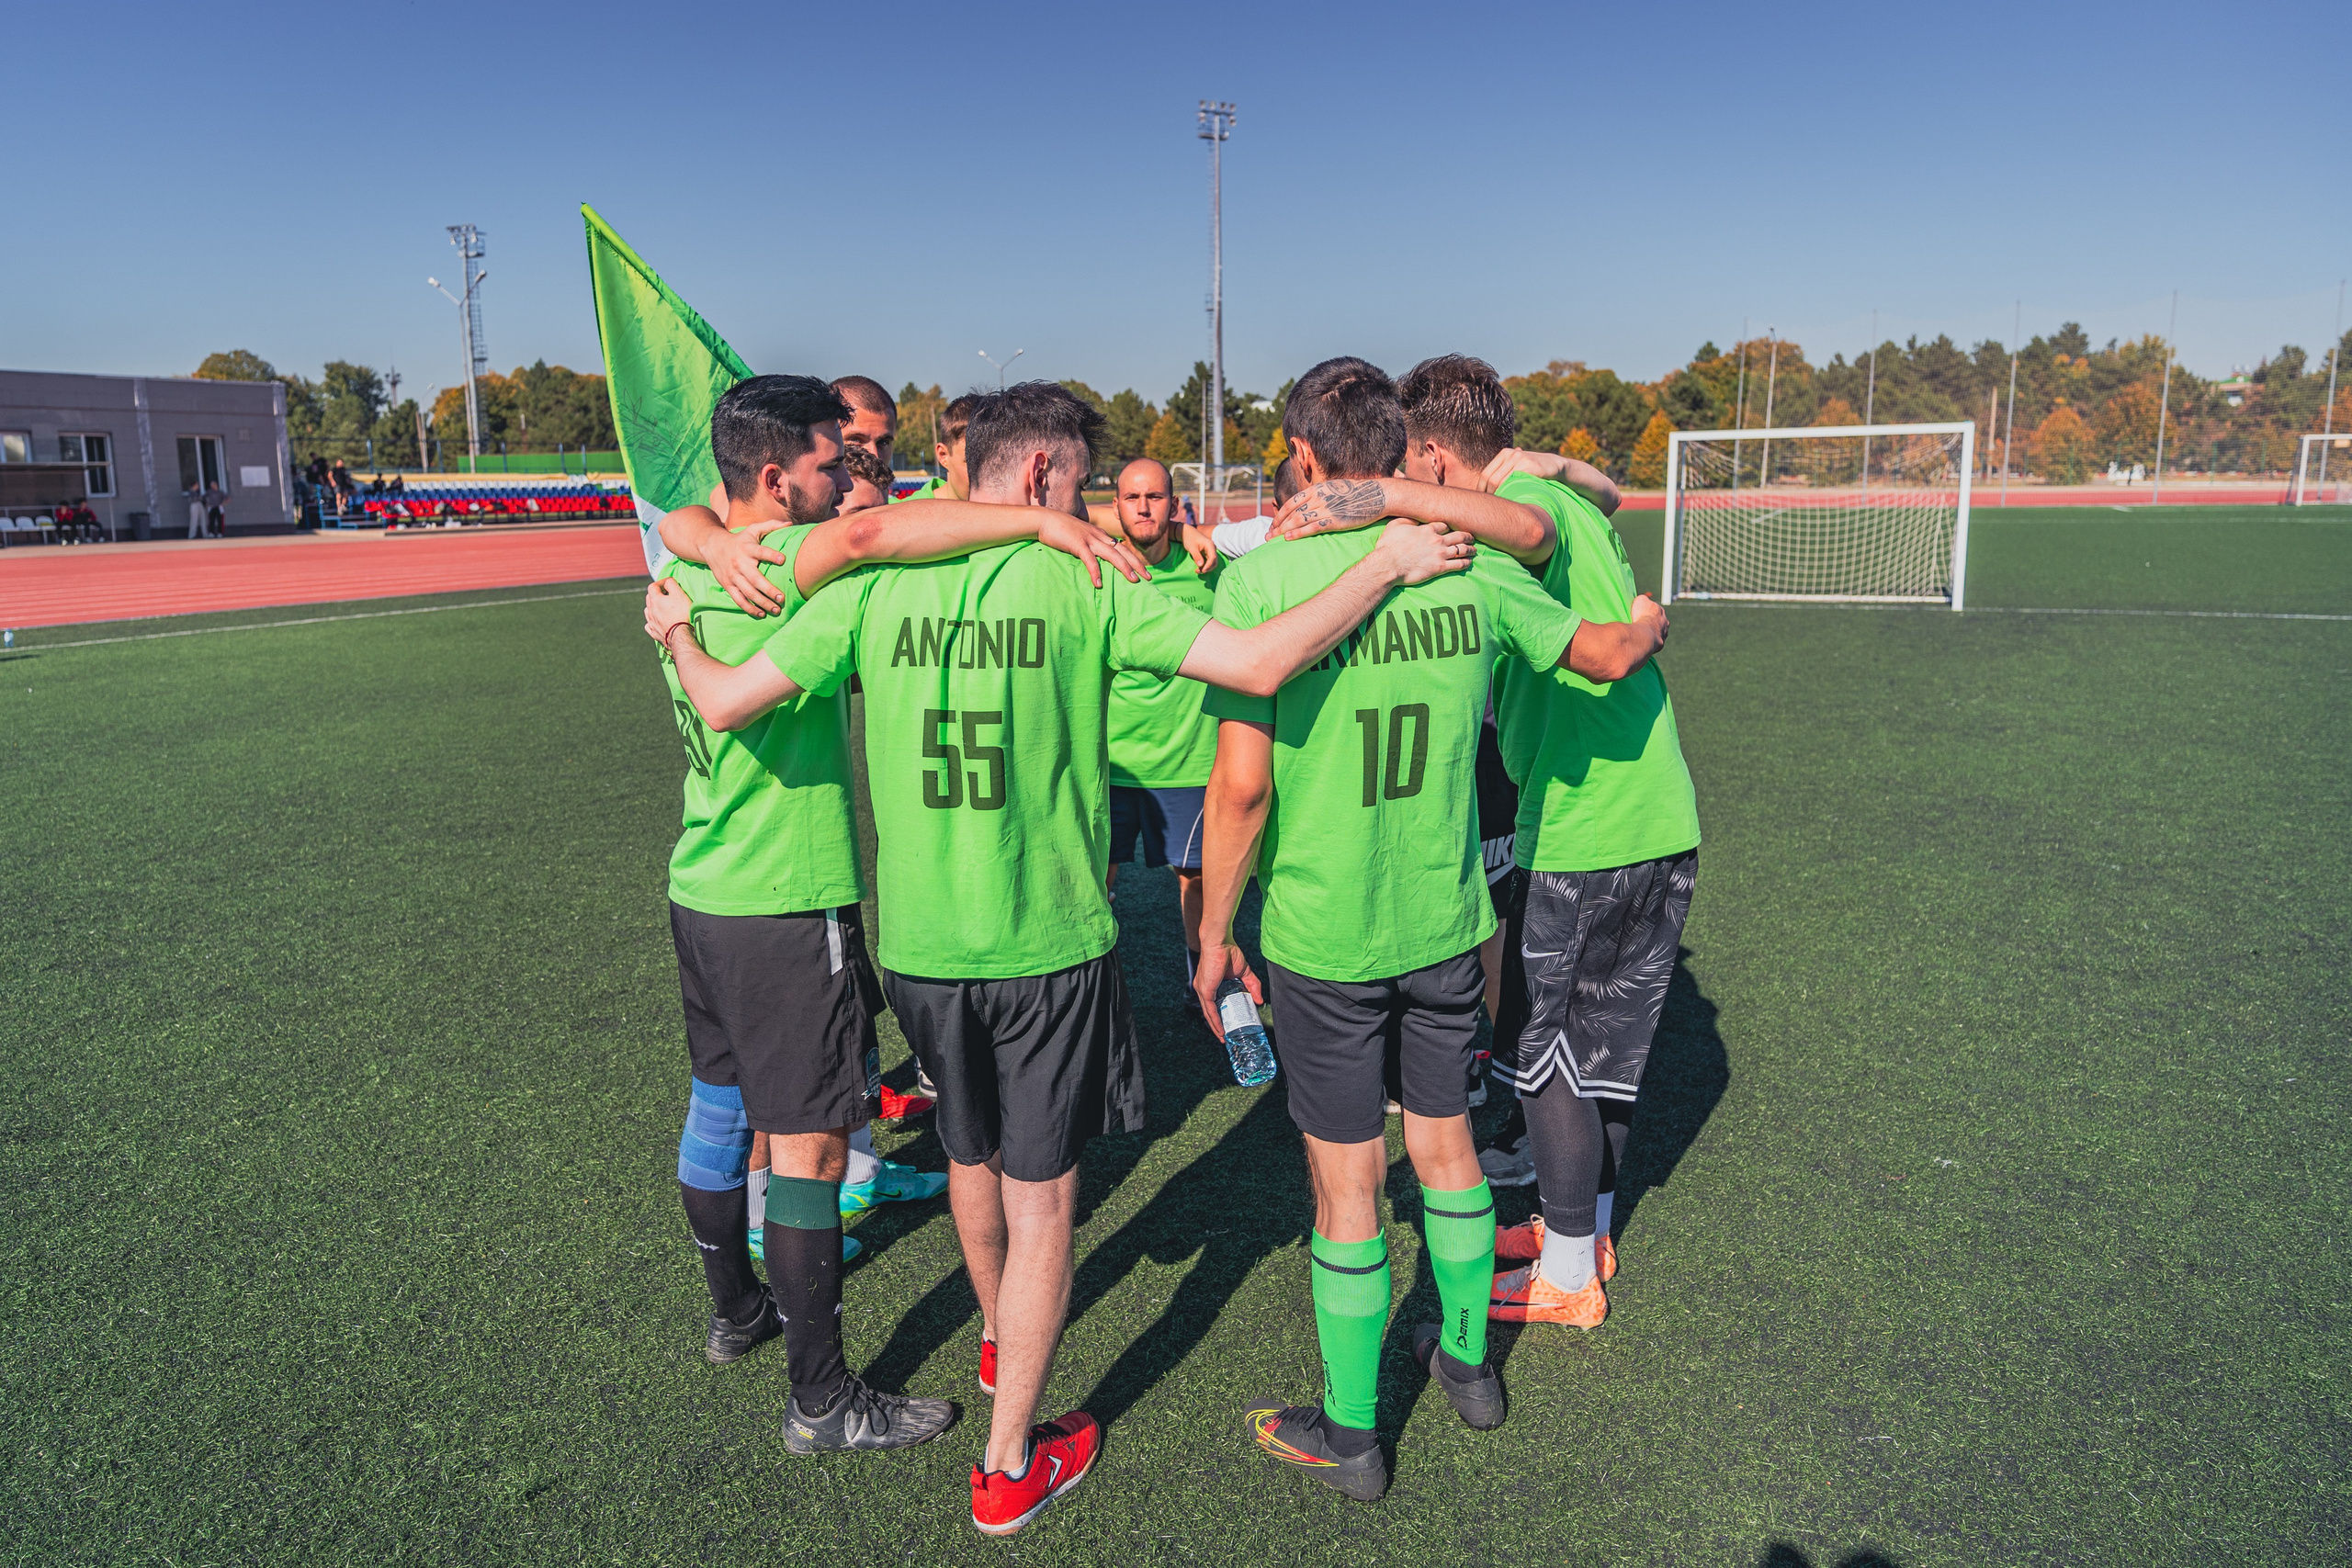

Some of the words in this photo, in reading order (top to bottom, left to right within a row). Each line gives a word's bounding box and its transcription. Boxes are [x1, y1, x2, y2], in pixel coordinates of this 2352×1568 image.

[890, 616, 1046, 670] ANTONIO
[1310, 604, 1481, 672] MANDO
[922, 708, 1006, 810] 55
[1355, 702, 1430, 807] 10
